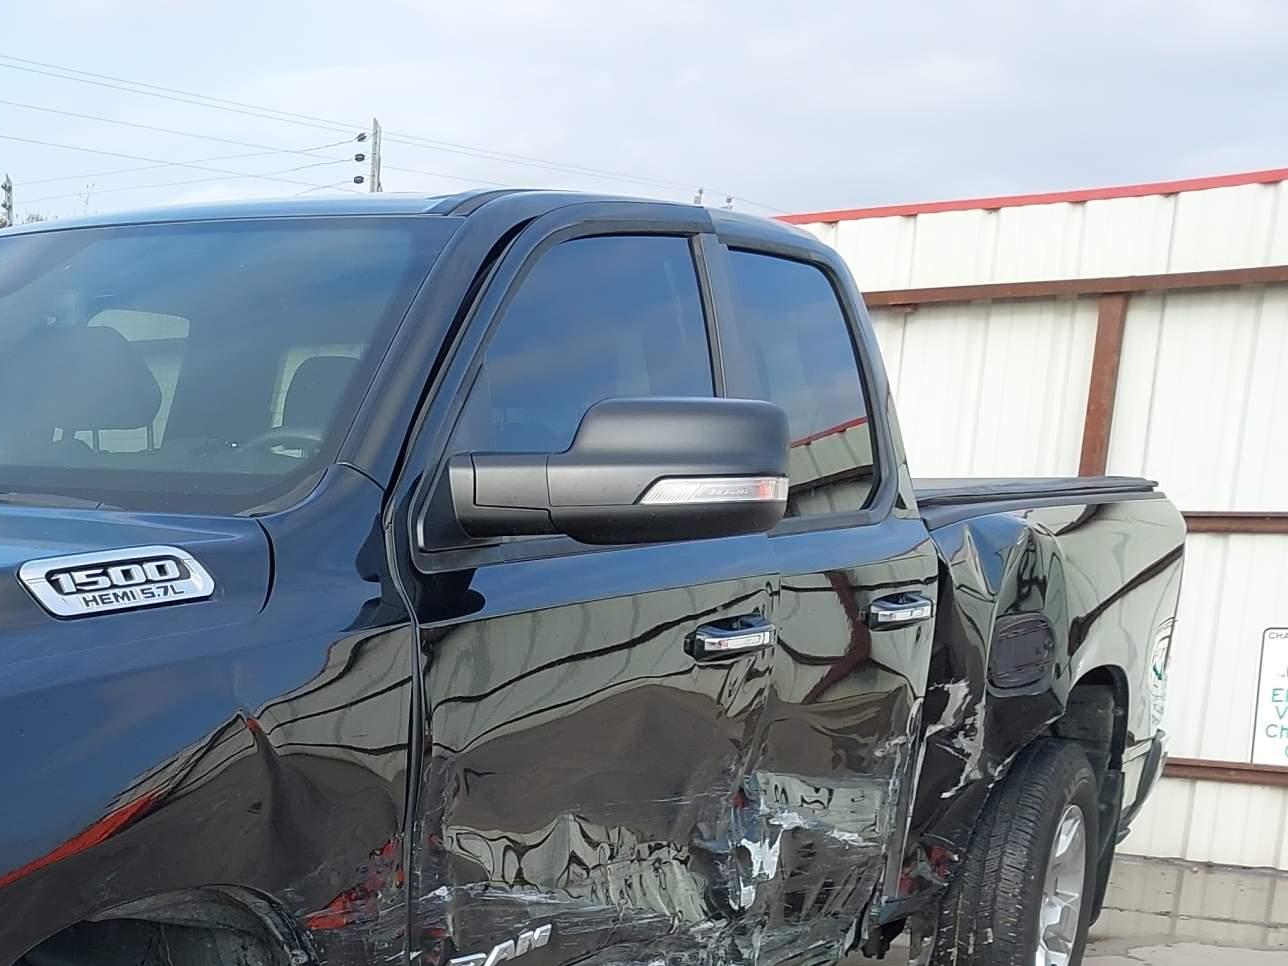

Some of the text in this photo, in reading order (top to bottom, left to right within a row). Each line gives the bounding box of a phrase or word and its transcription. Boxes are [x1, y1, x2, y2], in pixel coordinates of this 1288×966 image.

[51, 559, 181, 594] 1500
[83, 585, 185, 607] HEMI 5.7L
